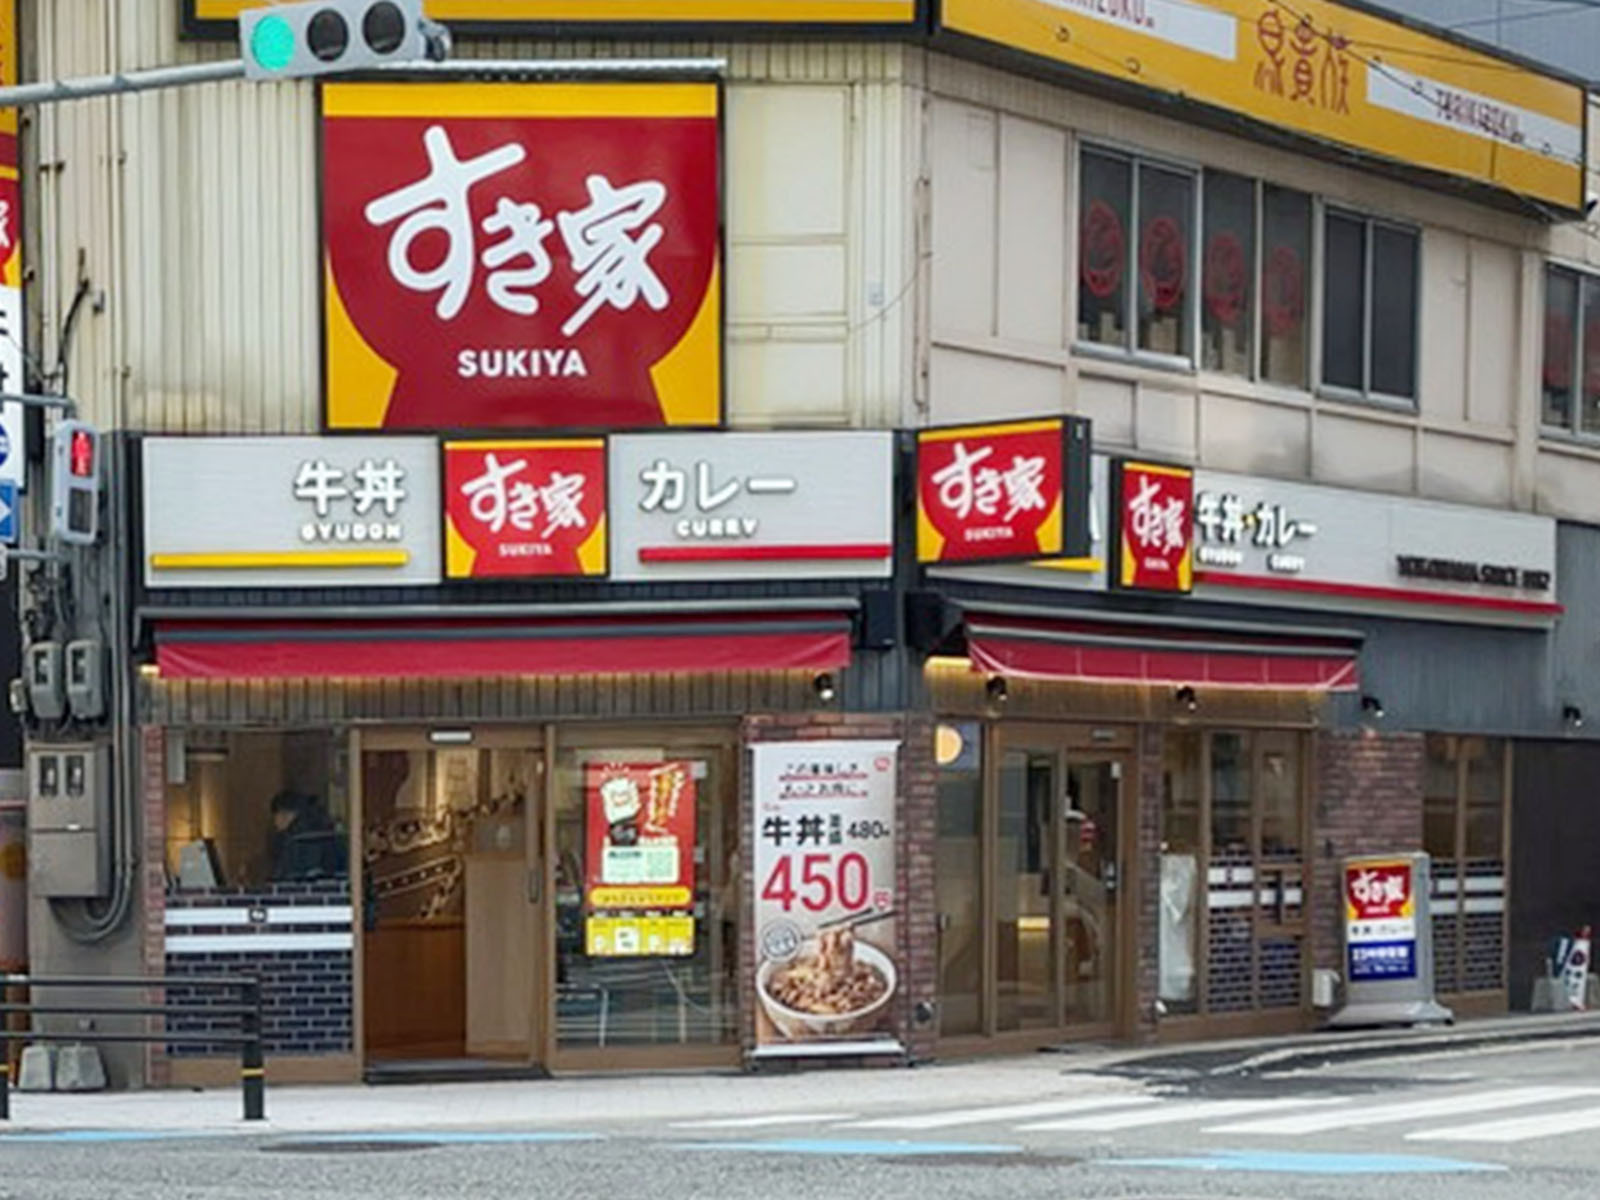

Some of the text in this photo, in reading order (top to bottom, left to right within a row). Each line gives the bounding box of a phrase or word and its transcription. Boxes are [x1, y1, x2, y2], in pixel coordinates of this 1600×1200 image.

[365, 125, 669, 336] すき家
[457, 349, 587, 377] SUKIYA
[293, 457, 407, 516] 牛丼
[460, 453, 587, 539] すき家
[639, 460, 797, 512] カレー
[931, 441, 1047, 523] すき家
[300, 522, 402, 542] GYUDON
[674, 518, 759, 538] CURRY
[1128, 474, 1186, 556] すき家
[498, 543, 553, 557] SUKIYA
[762, 814, 826, 847] 牛丼
